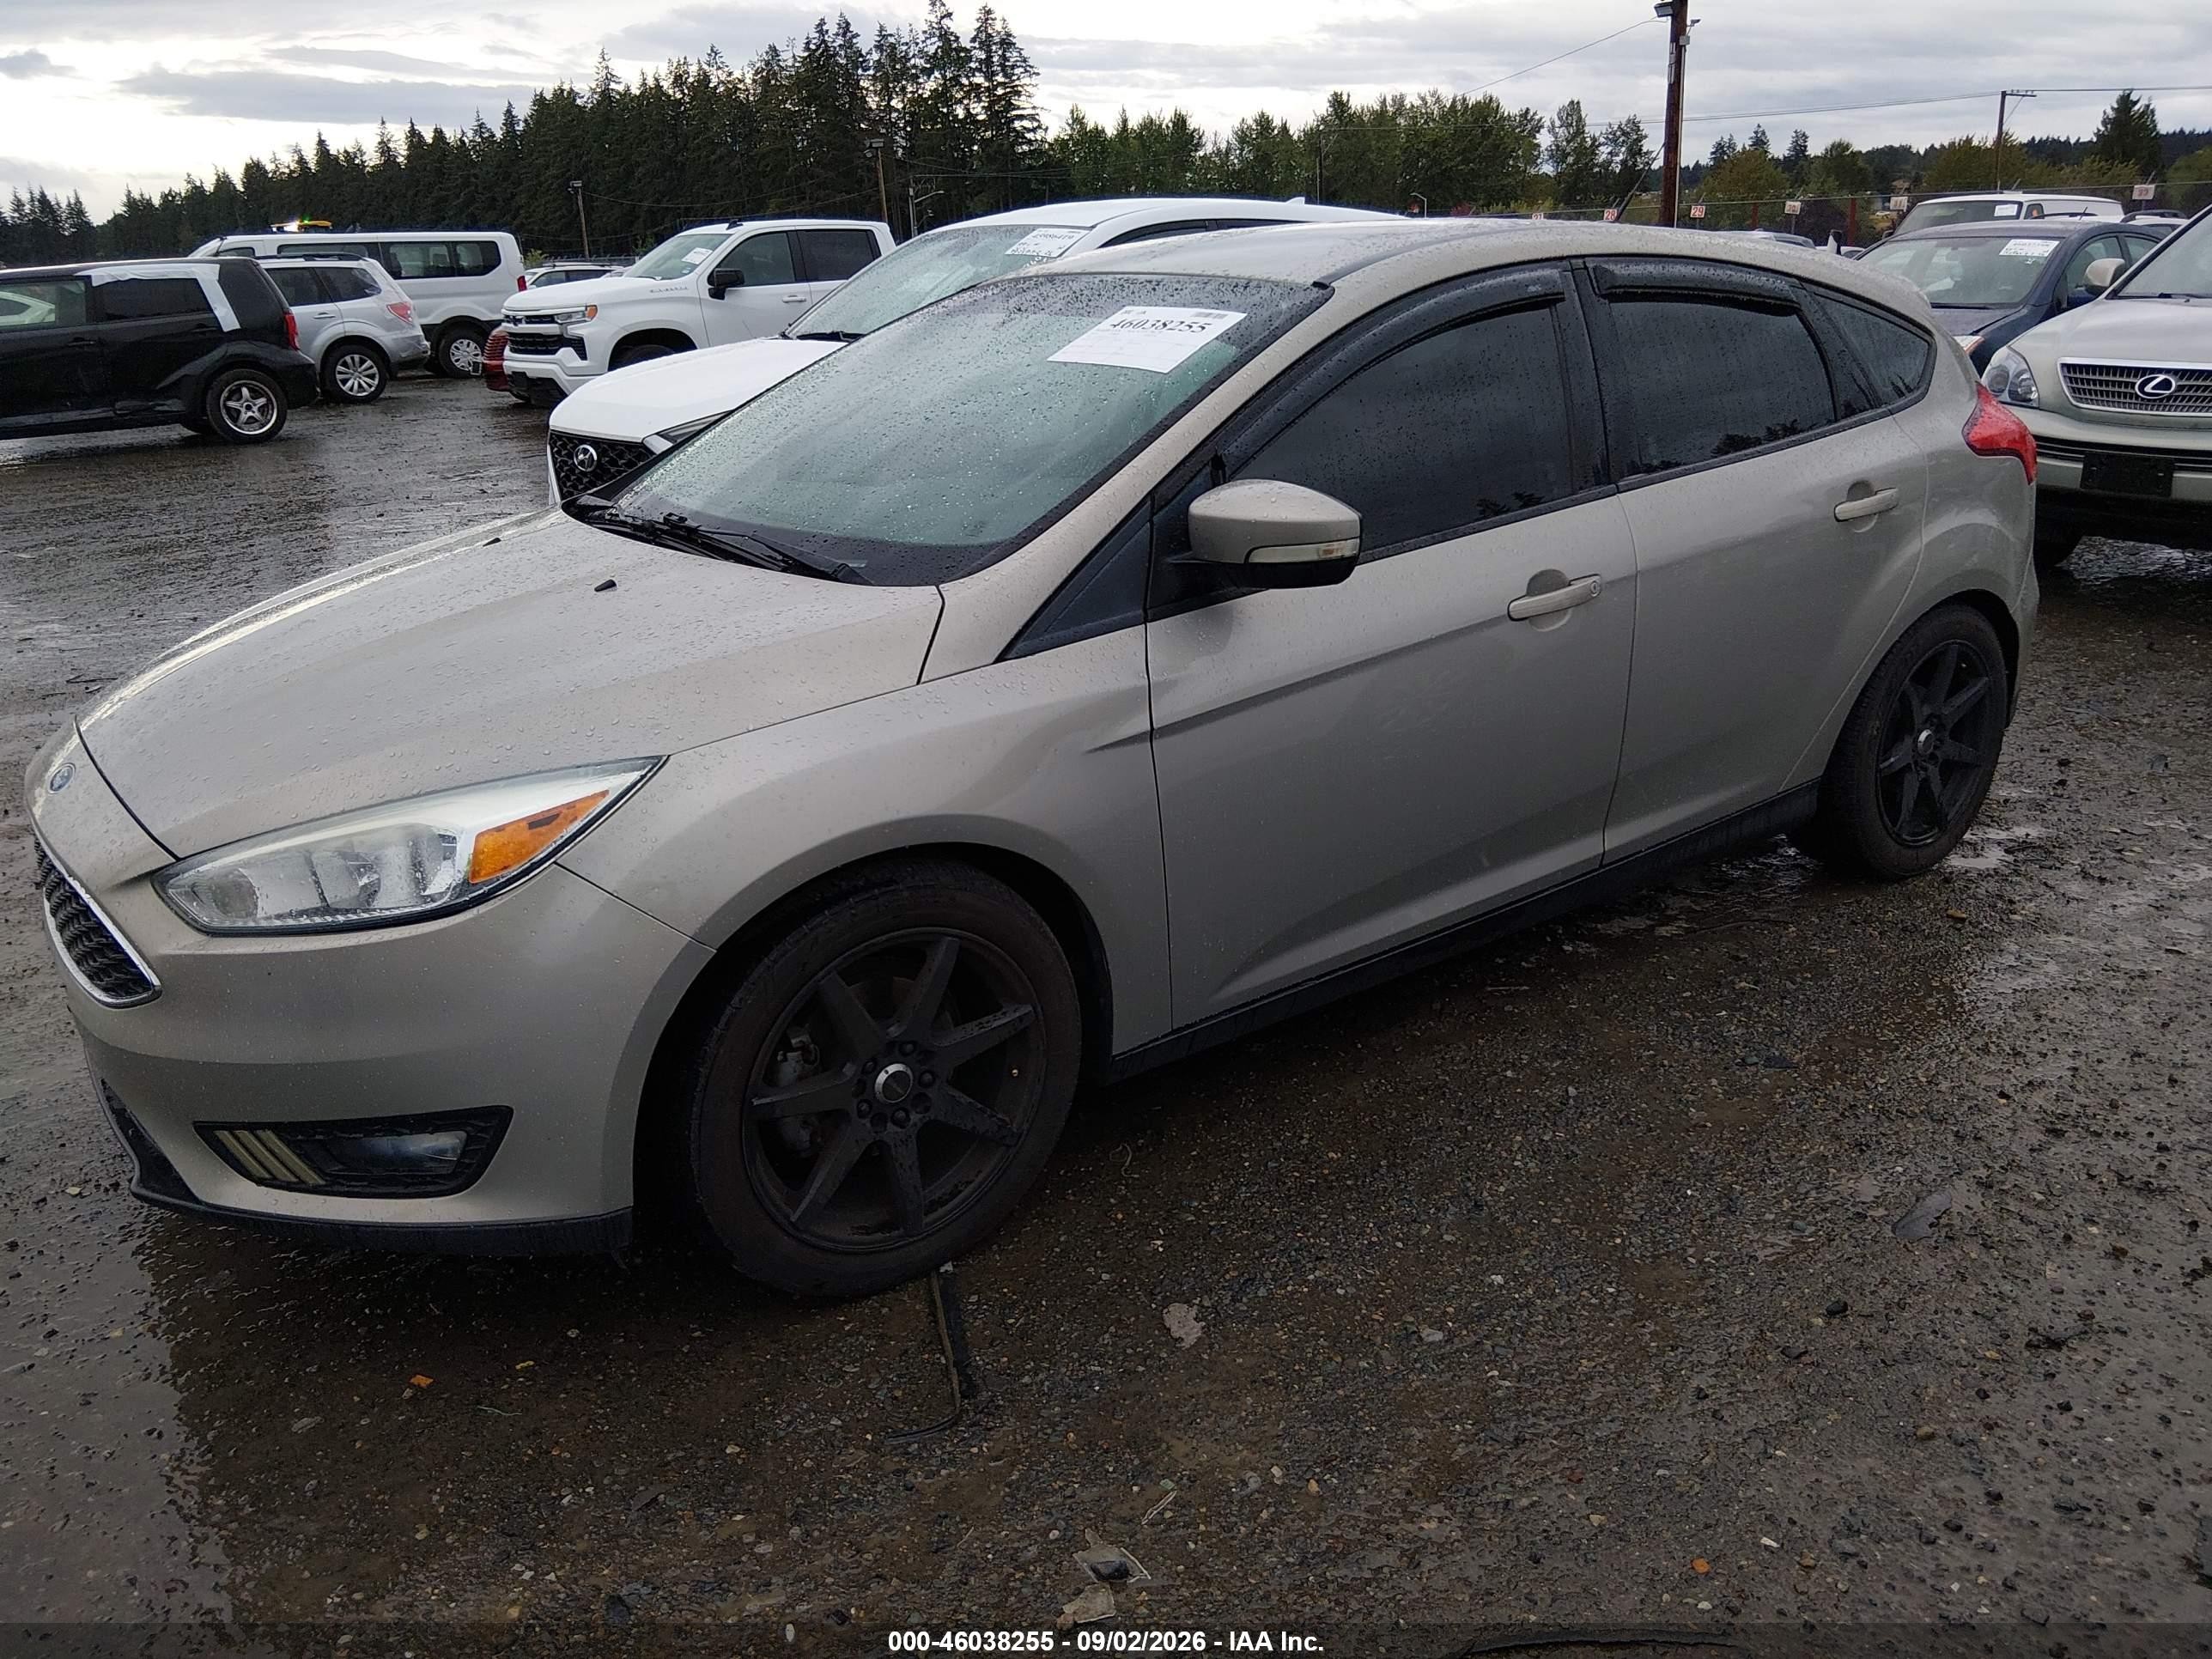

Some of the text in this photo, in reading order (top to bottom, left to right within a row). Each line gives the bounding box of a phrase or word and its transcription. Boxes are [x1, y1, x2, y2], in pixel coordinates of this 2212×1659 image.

[1605, 210, 1616, 221] 28
[1692, 206, 1705, 217] 29
[1109, 318, 1212, 333] 46038255
